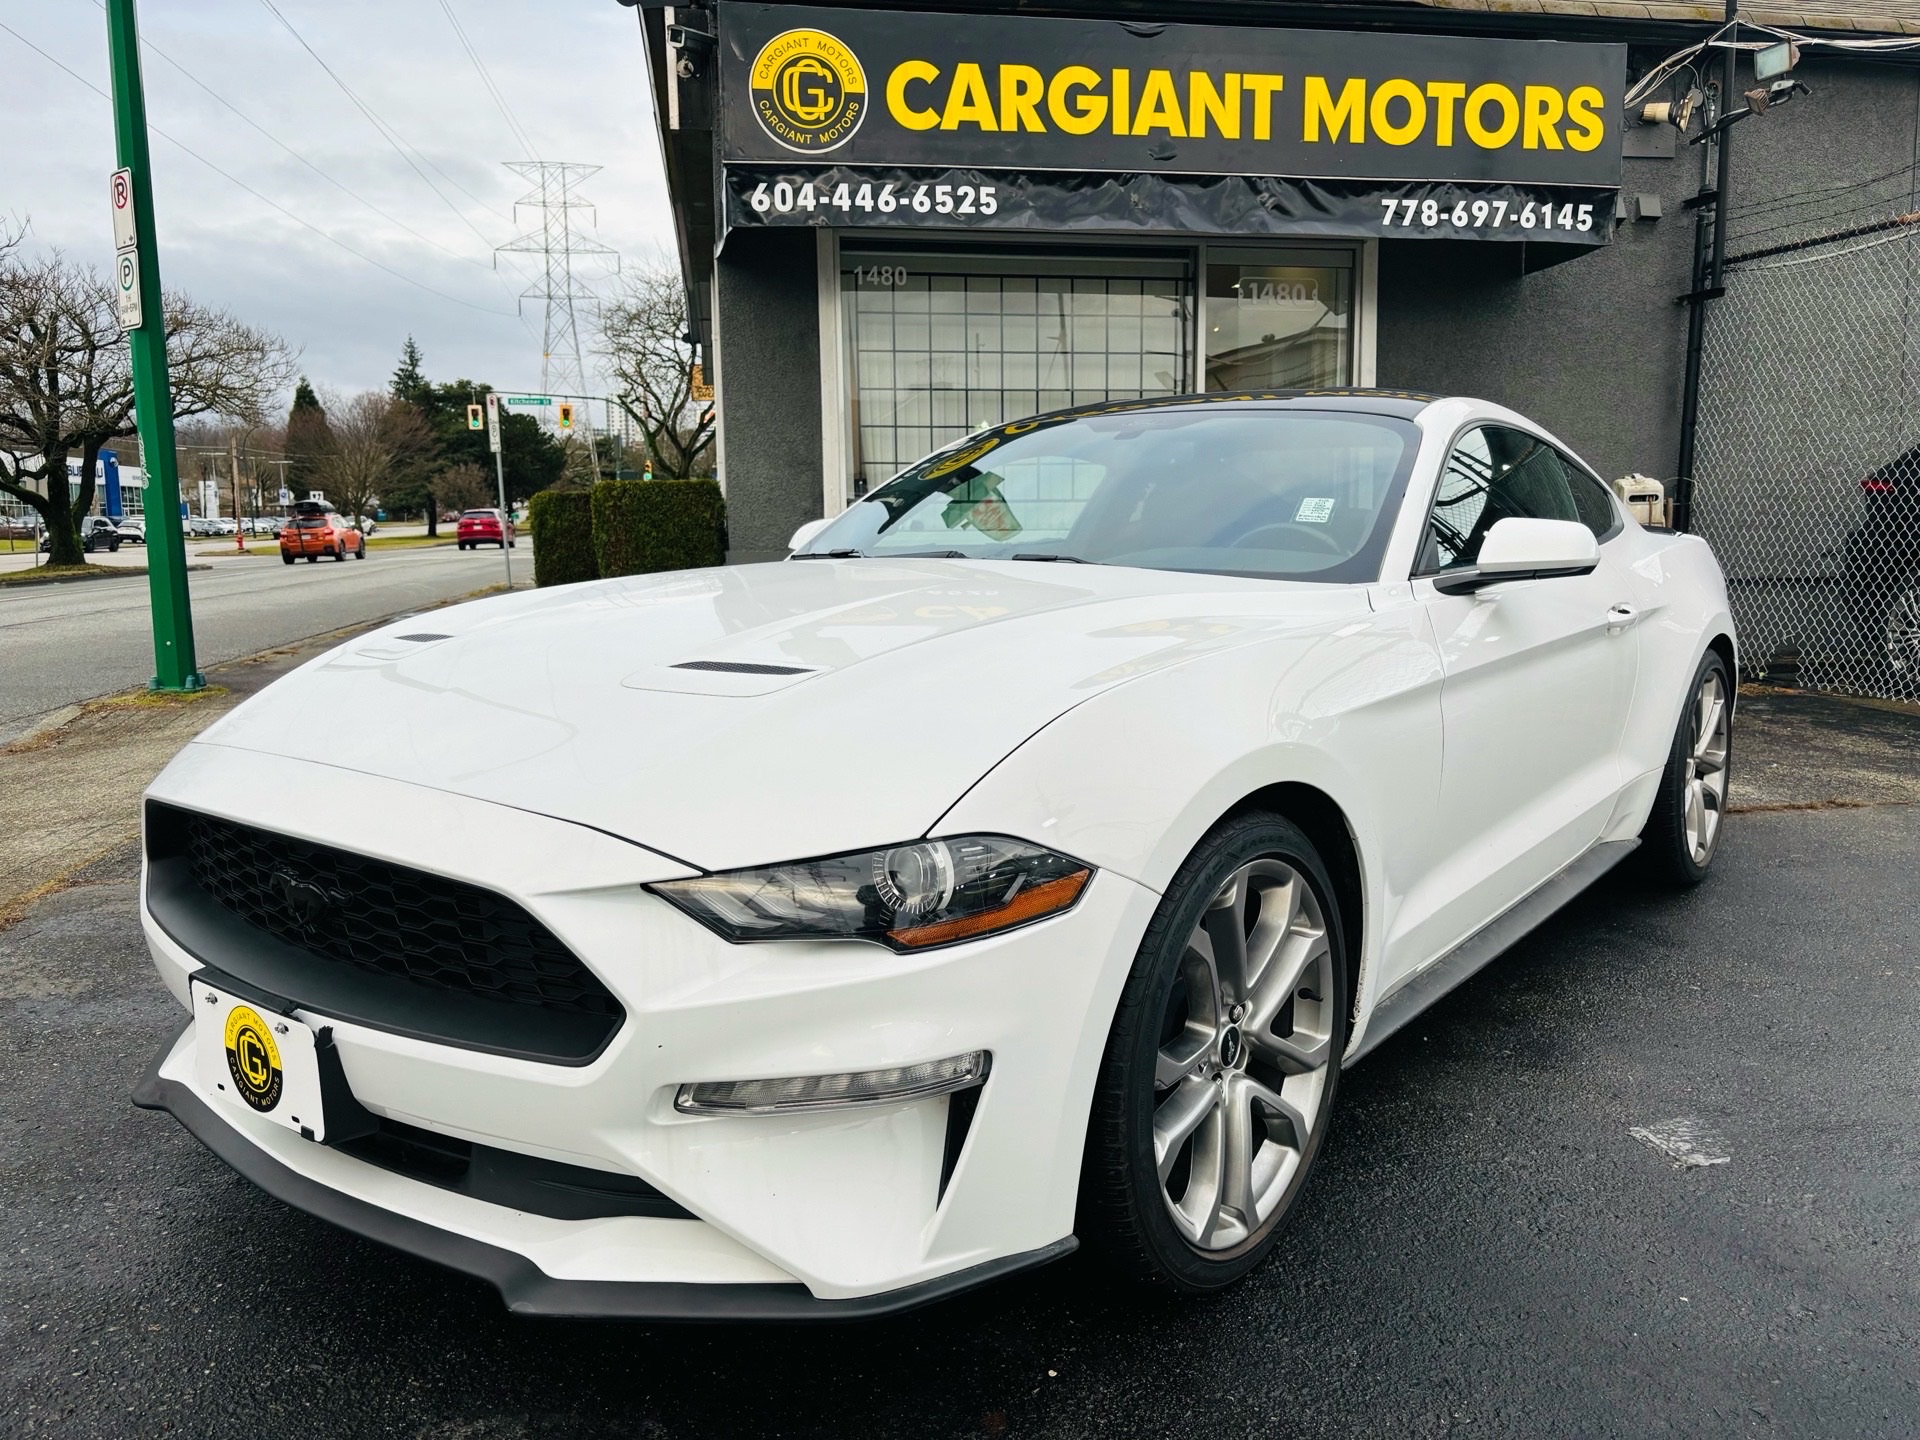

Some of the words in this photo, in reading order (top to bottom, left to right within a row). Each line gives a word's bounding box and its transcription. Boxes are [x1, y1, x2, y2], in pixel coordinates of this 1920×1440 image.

[760, 38, 810, 79] CARGIANT
[817, 41, 858, 85] MOTORS
[760, 100, 812, 144] CARGIANT
[819, 102, 859, 143] MOTORS
[886, 60, 1284, 141] CARGIANT
[1303, 76, 1605, 152] MOTORS
[750, 182, 998, 215] 604-446-6525
[1381, 199, 1594, 231] 778-697-6145
[854, 265, 907, 286] 1480
[1249, 282, 1307, 306] 1480
[228, 1013, 250, 1042] CARGIANT
[253, 1018, 278, 1061] MOTORS
[230, 1057, 259, 1104] CARGIANT
[262, 1076, 280, 1106] MOTORS
